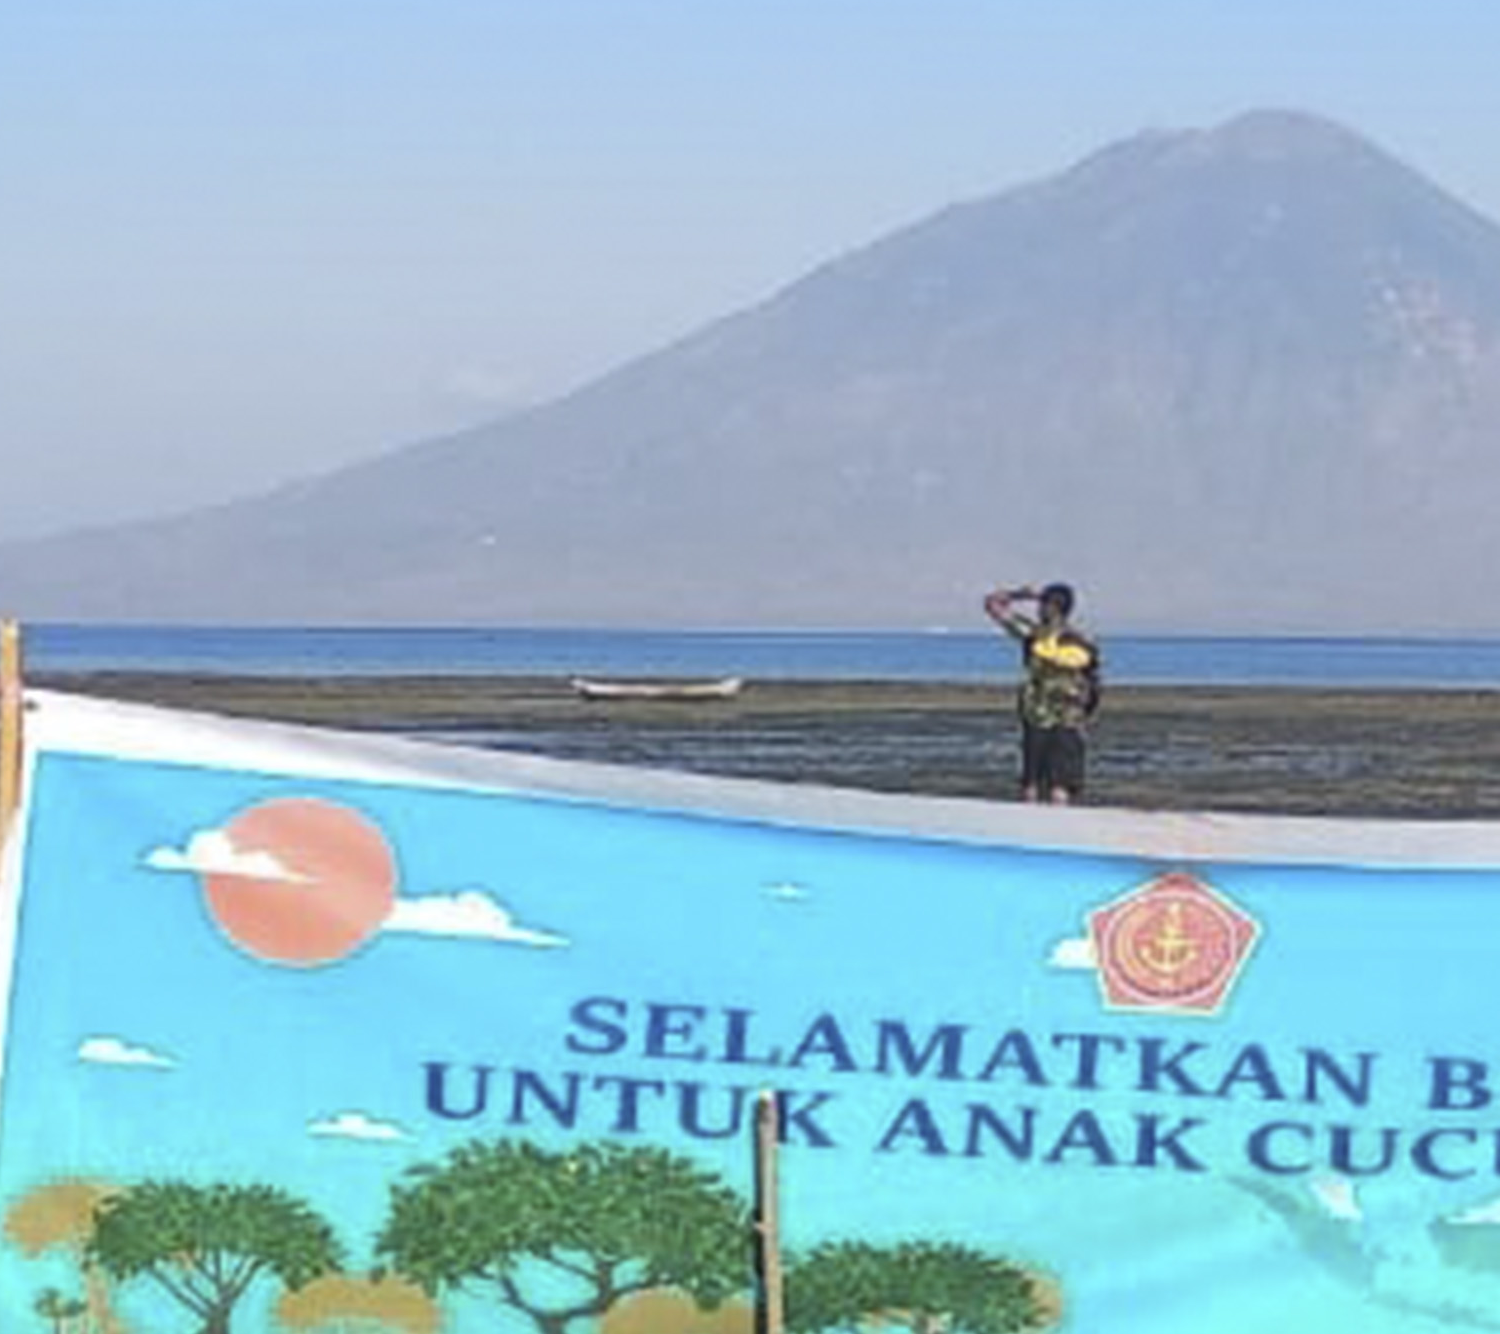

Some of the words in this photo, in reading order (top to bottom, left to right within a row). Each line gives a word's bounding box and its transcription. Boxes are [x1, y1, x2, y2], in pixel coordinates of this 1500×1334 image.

[564, 996, 1379, 1107] SELAMATKAN
[419, 1061, 836, 1149] UNTUK
[873, 1097, 1208, 1173] ANAK
